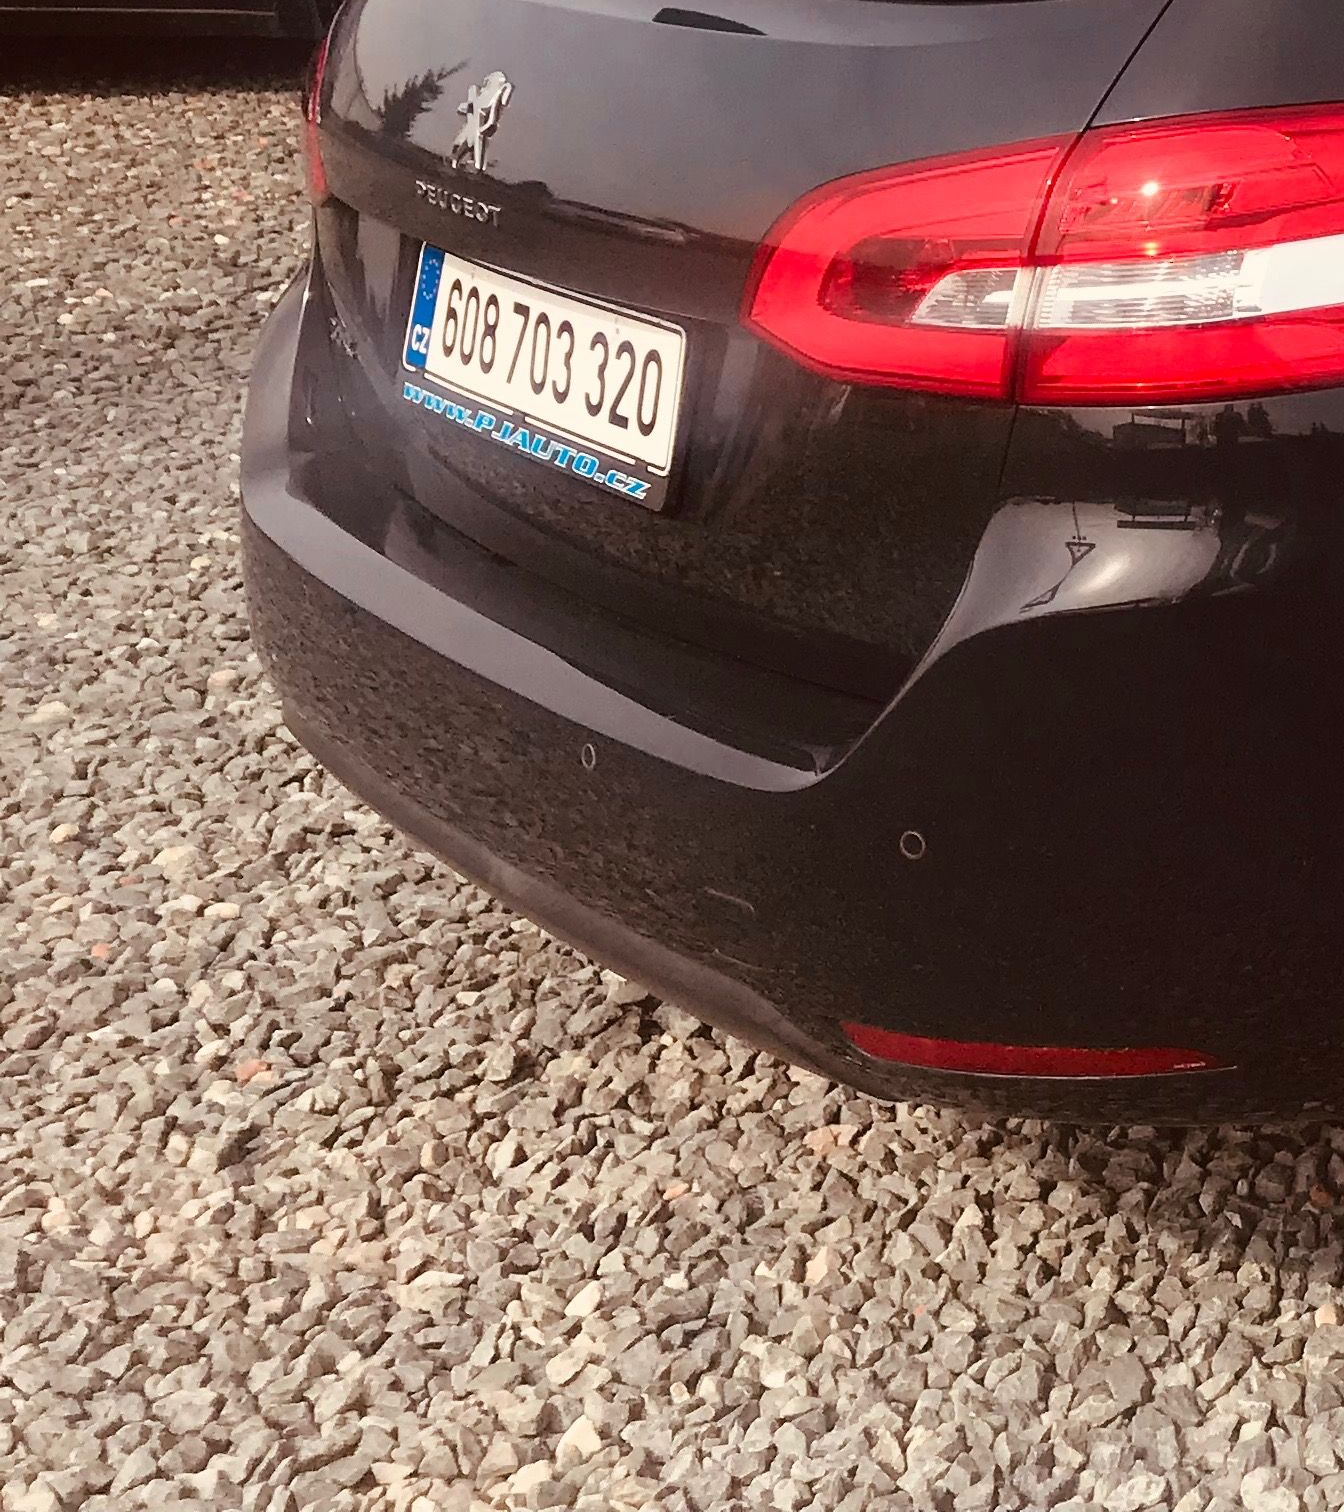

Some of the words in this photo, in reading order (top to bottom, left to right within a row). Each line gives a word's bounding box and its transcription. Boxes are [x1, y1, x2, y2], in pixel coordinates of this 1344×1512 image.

[415, 179, 502, 228] PEUGEOT
[410, 323, 430, 354] CZ
[442, 278, 500, 374] 608
[506, 301, 575, 404] 703
[585, 331, 663, 437] 320
